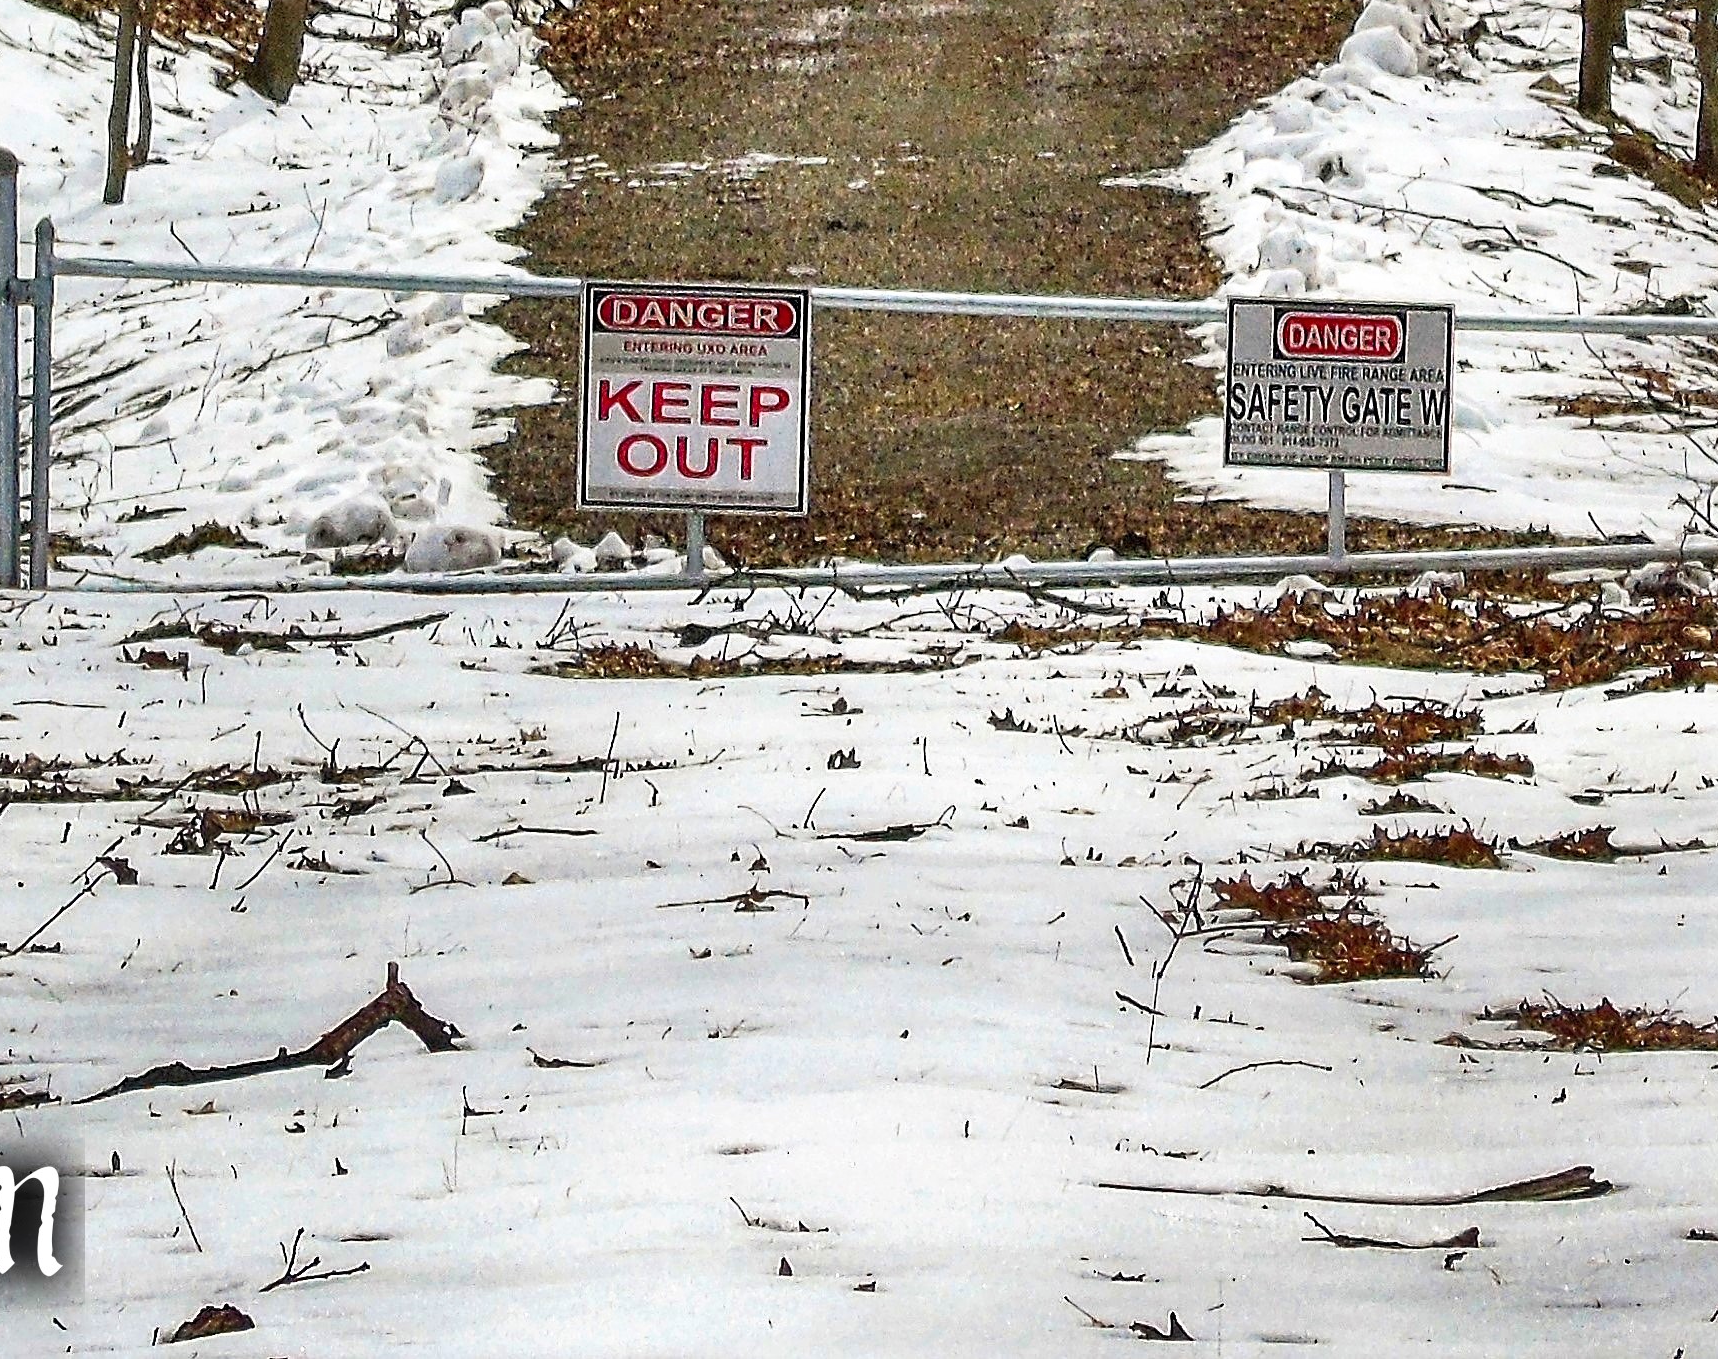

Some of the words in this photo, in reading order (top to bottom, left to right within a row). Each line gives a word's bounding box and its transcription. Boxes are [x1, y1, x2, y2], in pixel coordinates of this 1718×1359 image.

[612, 299, 779, 331] DANGER
[623, 340, 693, 355] ENTERING
[697, 342, 726, 355] UXO
[730, 343, 769, 357] AREA
[1289, 323, 1392, 353] DANGER
[1233, 363, 1297, 379] ENTERING
[1299, 365, 1326, 380] LIVE
[1330, 365, 1358, 381] FIRE
[1362, 366, 1406, 383] RANGE
[1410, 368, 1444, 384] AREA
[598, 379, 791, 428] KEEP
[1230, 382, 1334, 423] SAFETY
[1341, 385, 1413, 426] GATE
[1420, 388, 1447, 427] W
[1231, 422, 1273, 434] CONTACT
[616, 432, 769, 481] OUT
